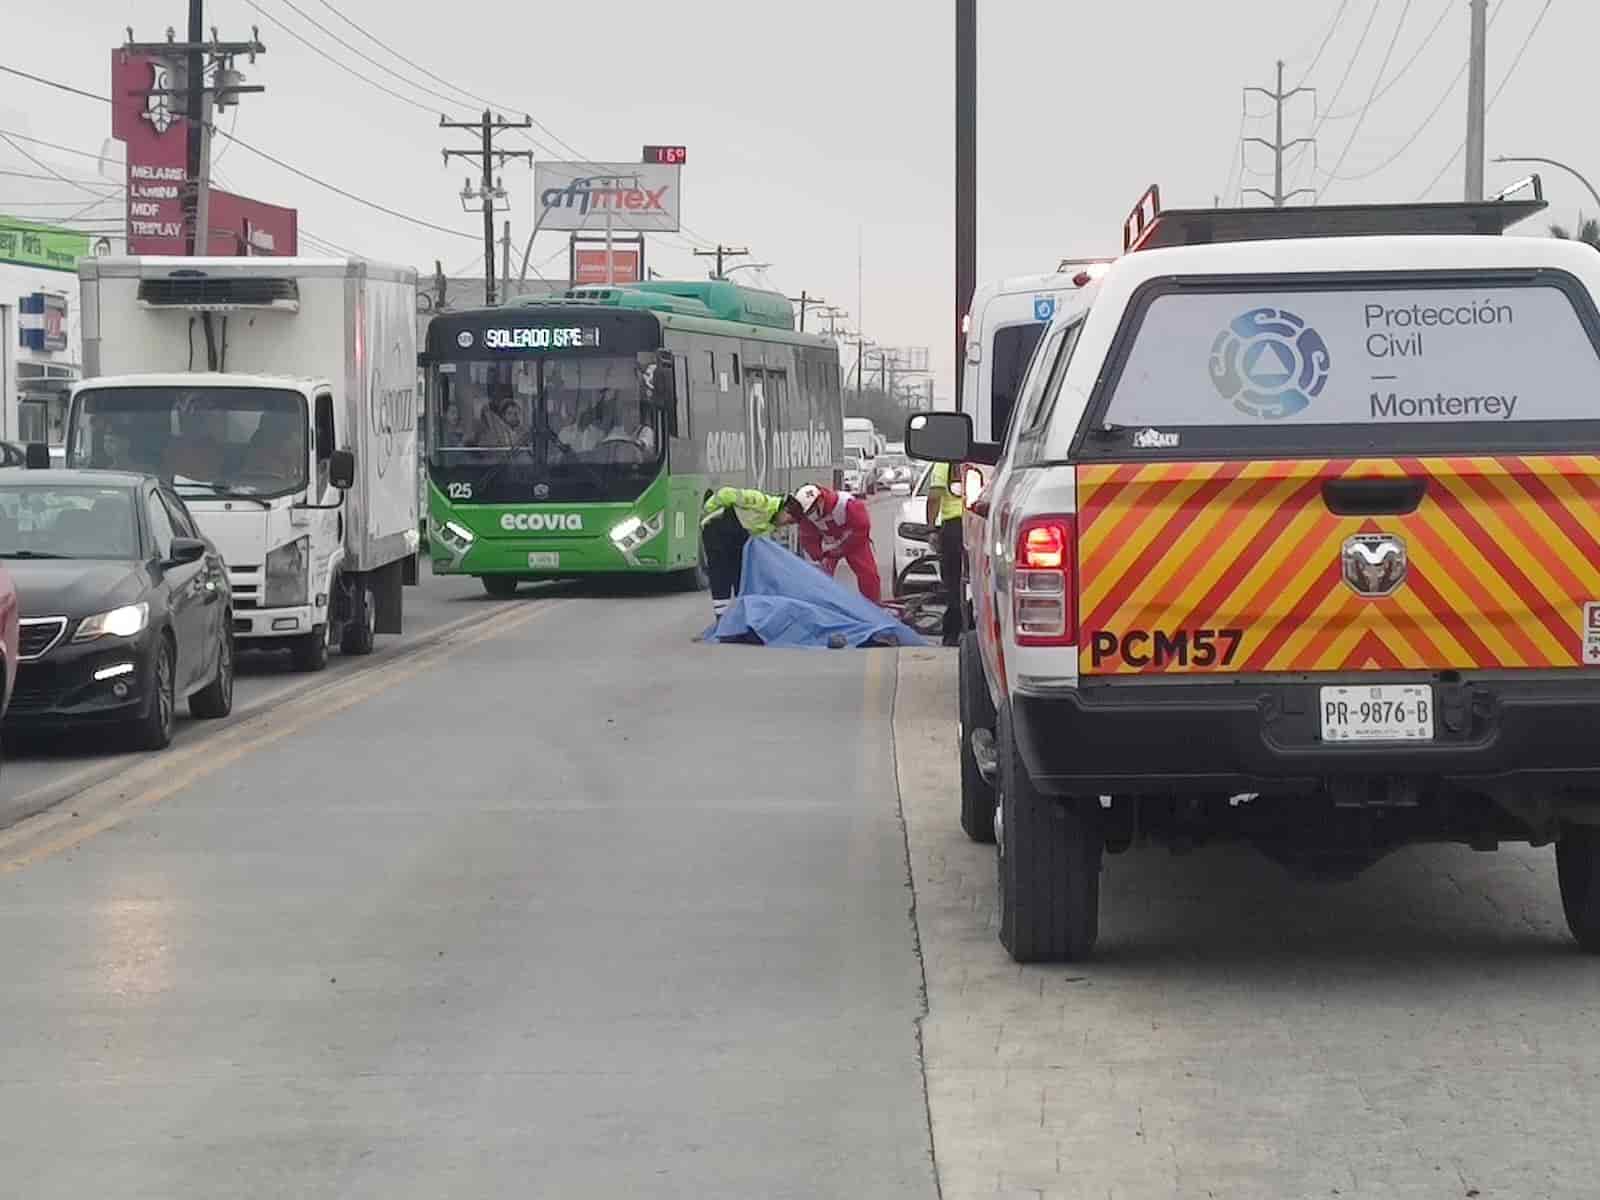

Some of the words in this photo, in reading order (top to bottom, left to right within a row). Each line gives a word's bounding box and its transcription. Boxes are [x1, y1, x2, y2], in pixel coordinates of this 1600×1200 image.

[131, 203, 160, 217] MDF
[131, 221, 181, 239] TRIPLAY
[1364, 298, 1513, 329] Protección
[485, 327, 549, 347] SOLEADO
[1366, 332, 1423, 358] Civil
[1370, 392, 1518, 420] Monterrey
[447, 482, 472, 499] 125
[500, 513, 584, 531] ecovia
[1091, 629, 1243, 668] PCM57
[1326, 701, 1428, 724] PR-9876-B
